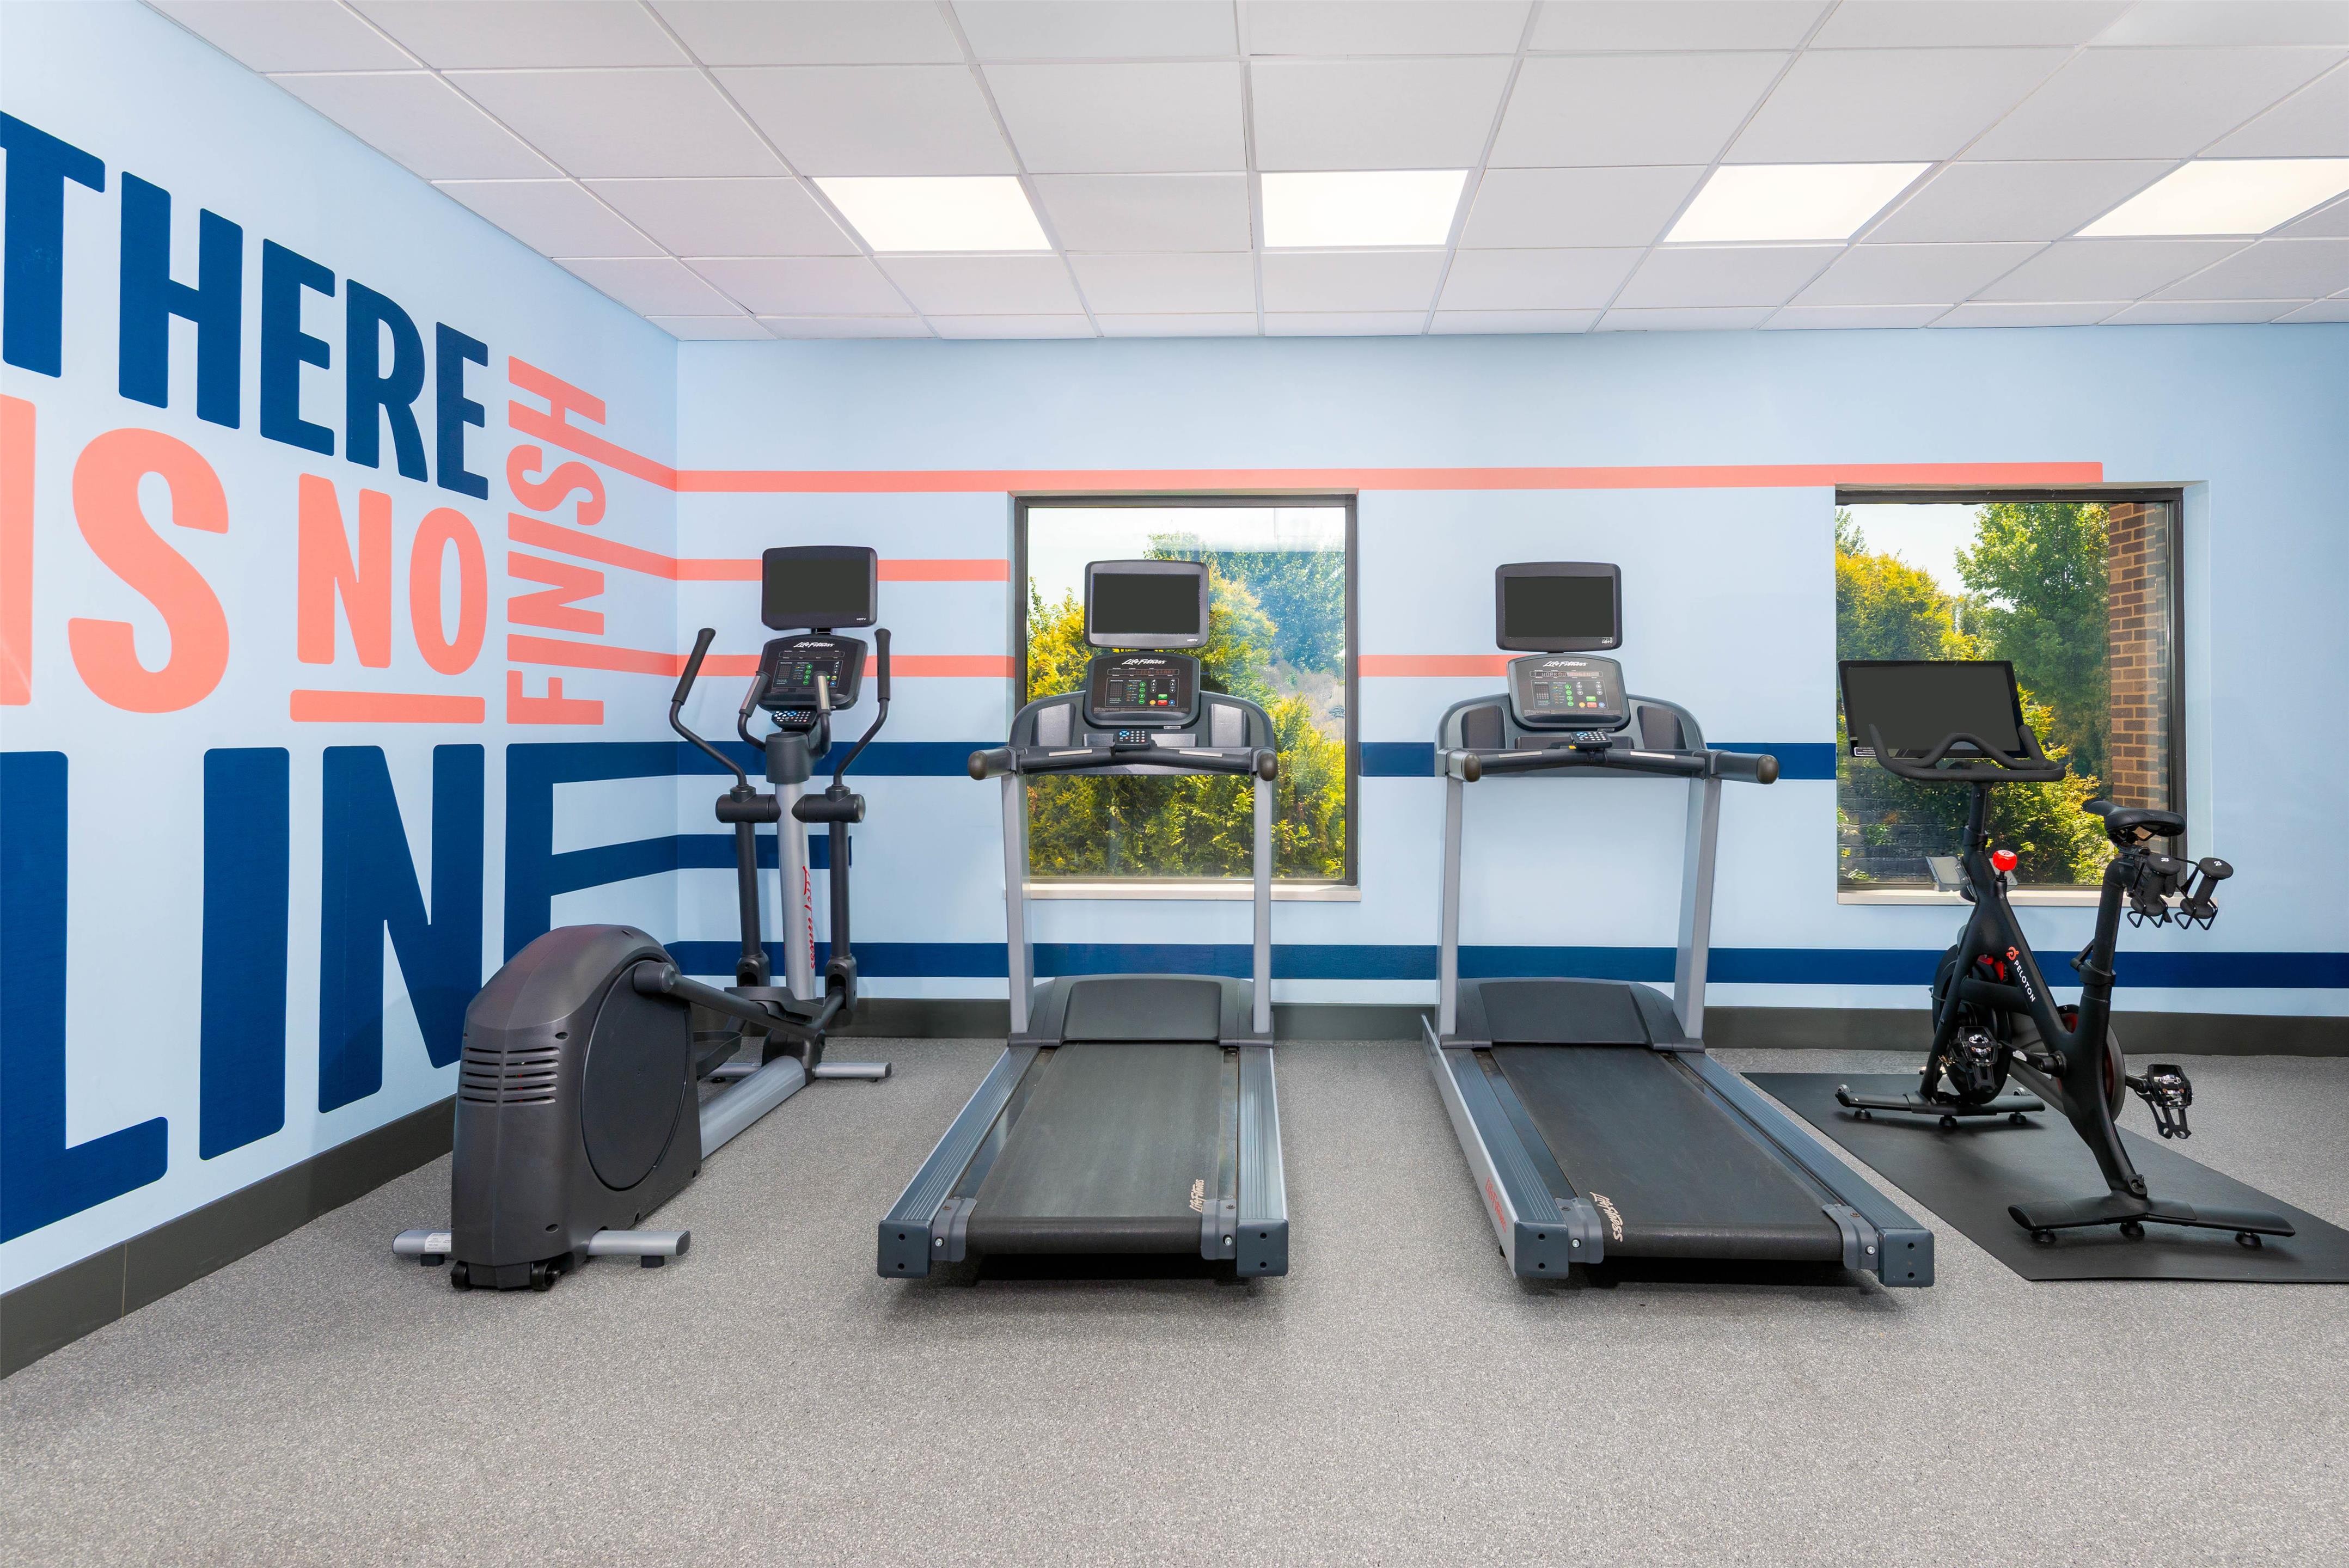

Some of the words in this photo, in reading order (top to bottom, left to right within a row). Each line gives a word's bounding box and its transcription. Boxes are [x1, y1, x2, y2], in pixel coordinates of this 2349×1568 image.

[0, 111, 488, 500] THERE
[296, 473, 487, 676] NO
[506, 355, 607, 725] FINISH
[2014, 960, 2035, 1002] PELOTON
